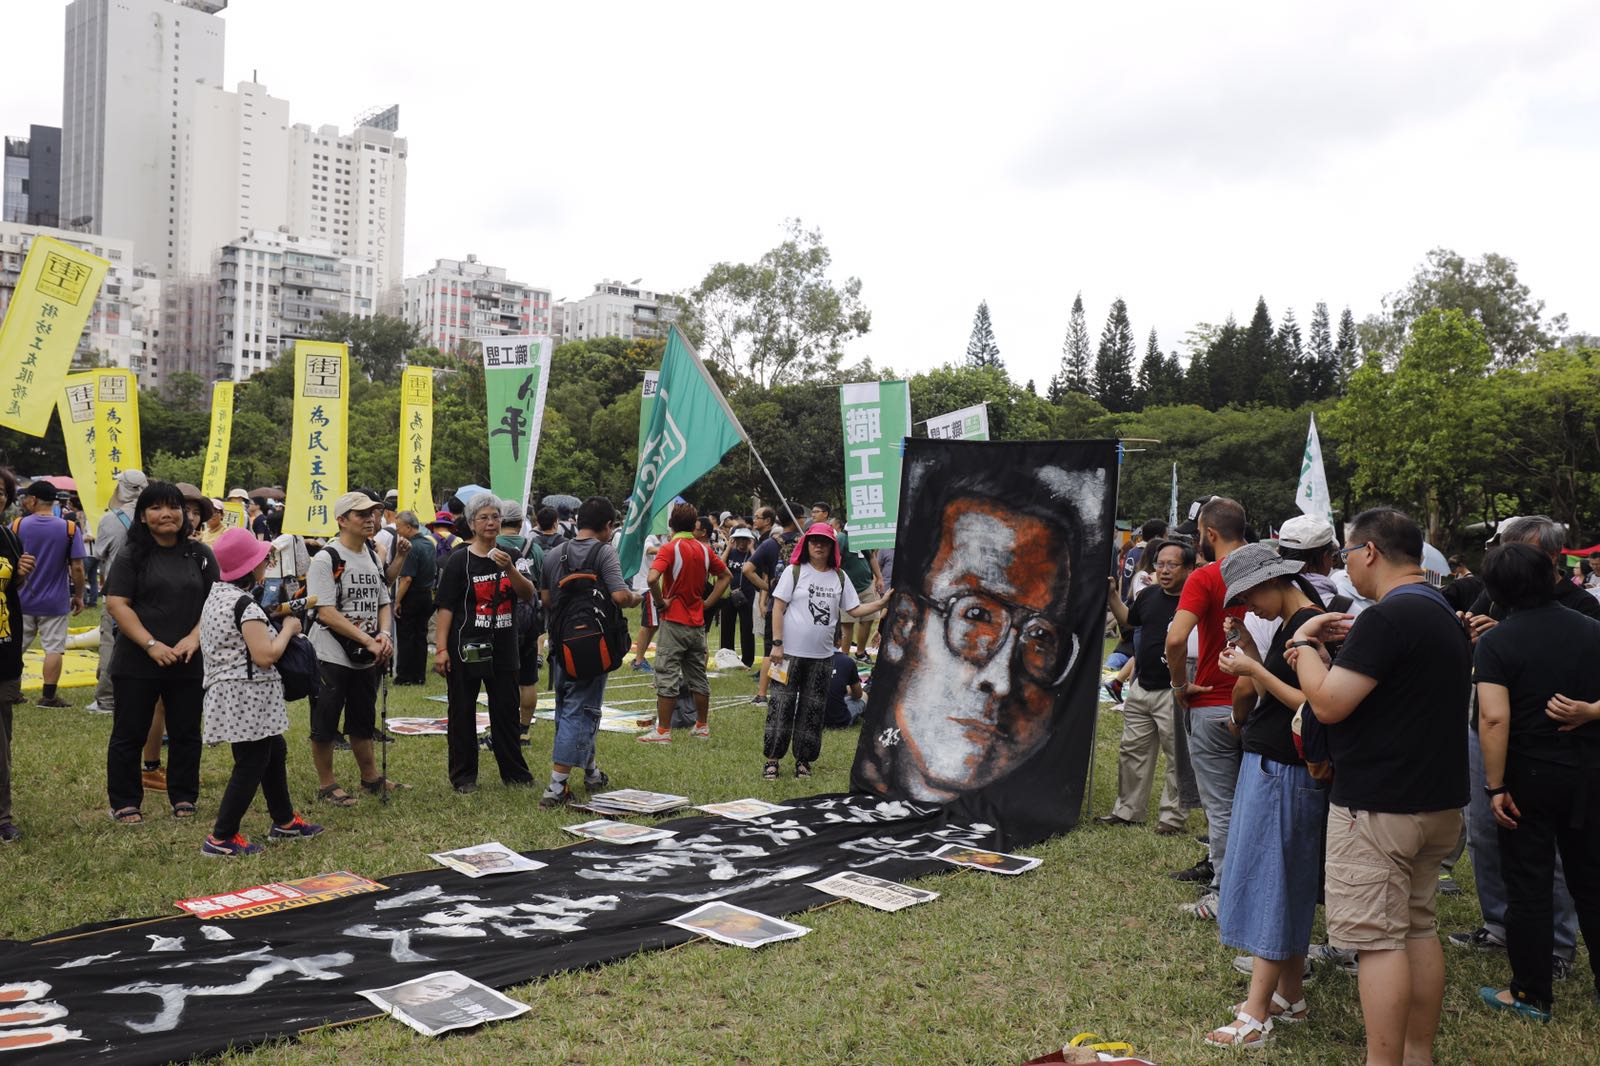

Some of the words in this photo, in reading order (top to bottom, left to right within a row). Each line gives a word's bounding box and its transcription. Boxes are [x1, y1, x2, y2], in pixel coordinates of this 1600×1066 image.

[379, 158, 387, 198] THE
[307, 358, 339, 387] 街工
[351, 574, 378, 585] LEGO
[347, 587, 379, 599] PARTY
[352, 601, 377, 612] TIME
[327, 884, 385, 901] FREE
